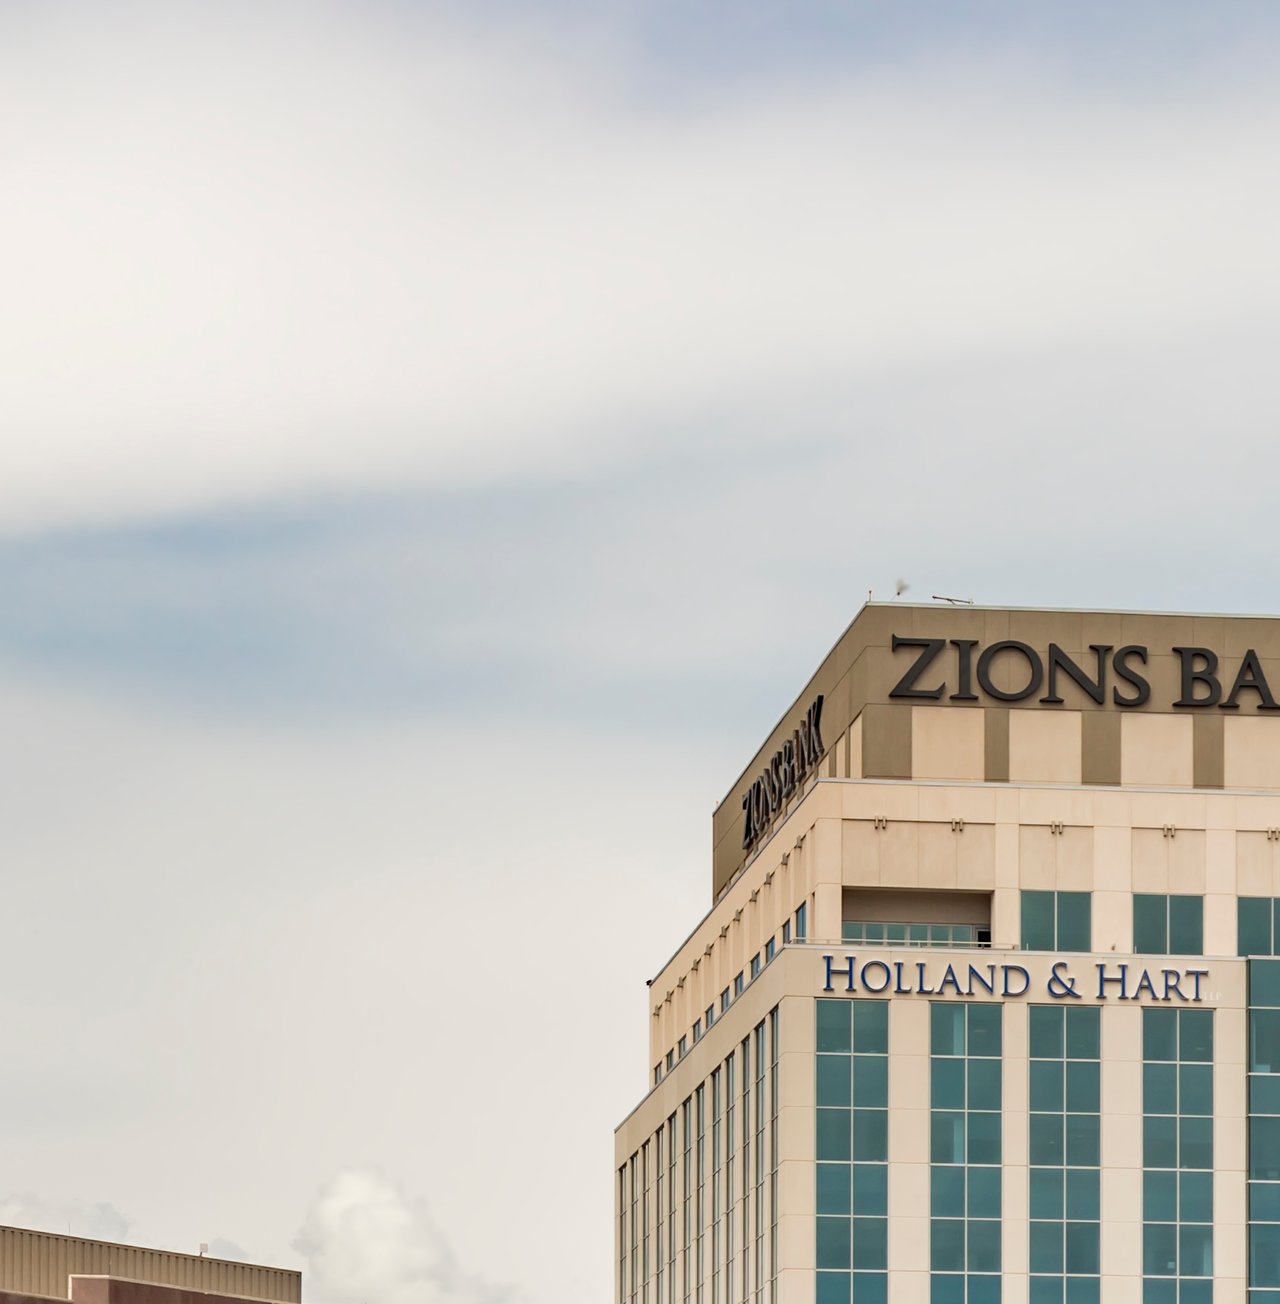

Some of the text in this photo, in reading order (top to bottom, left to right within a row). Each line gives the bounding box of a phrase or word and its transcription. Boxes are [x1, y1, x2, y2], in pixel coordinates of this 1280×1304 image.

[888, 633, 1152, 706] ZIONS
[822, 955, 1031, 996] HOLLAND
[1047, 961, 1082, 998] &
[1095, 963, 1209, 1001] HART
